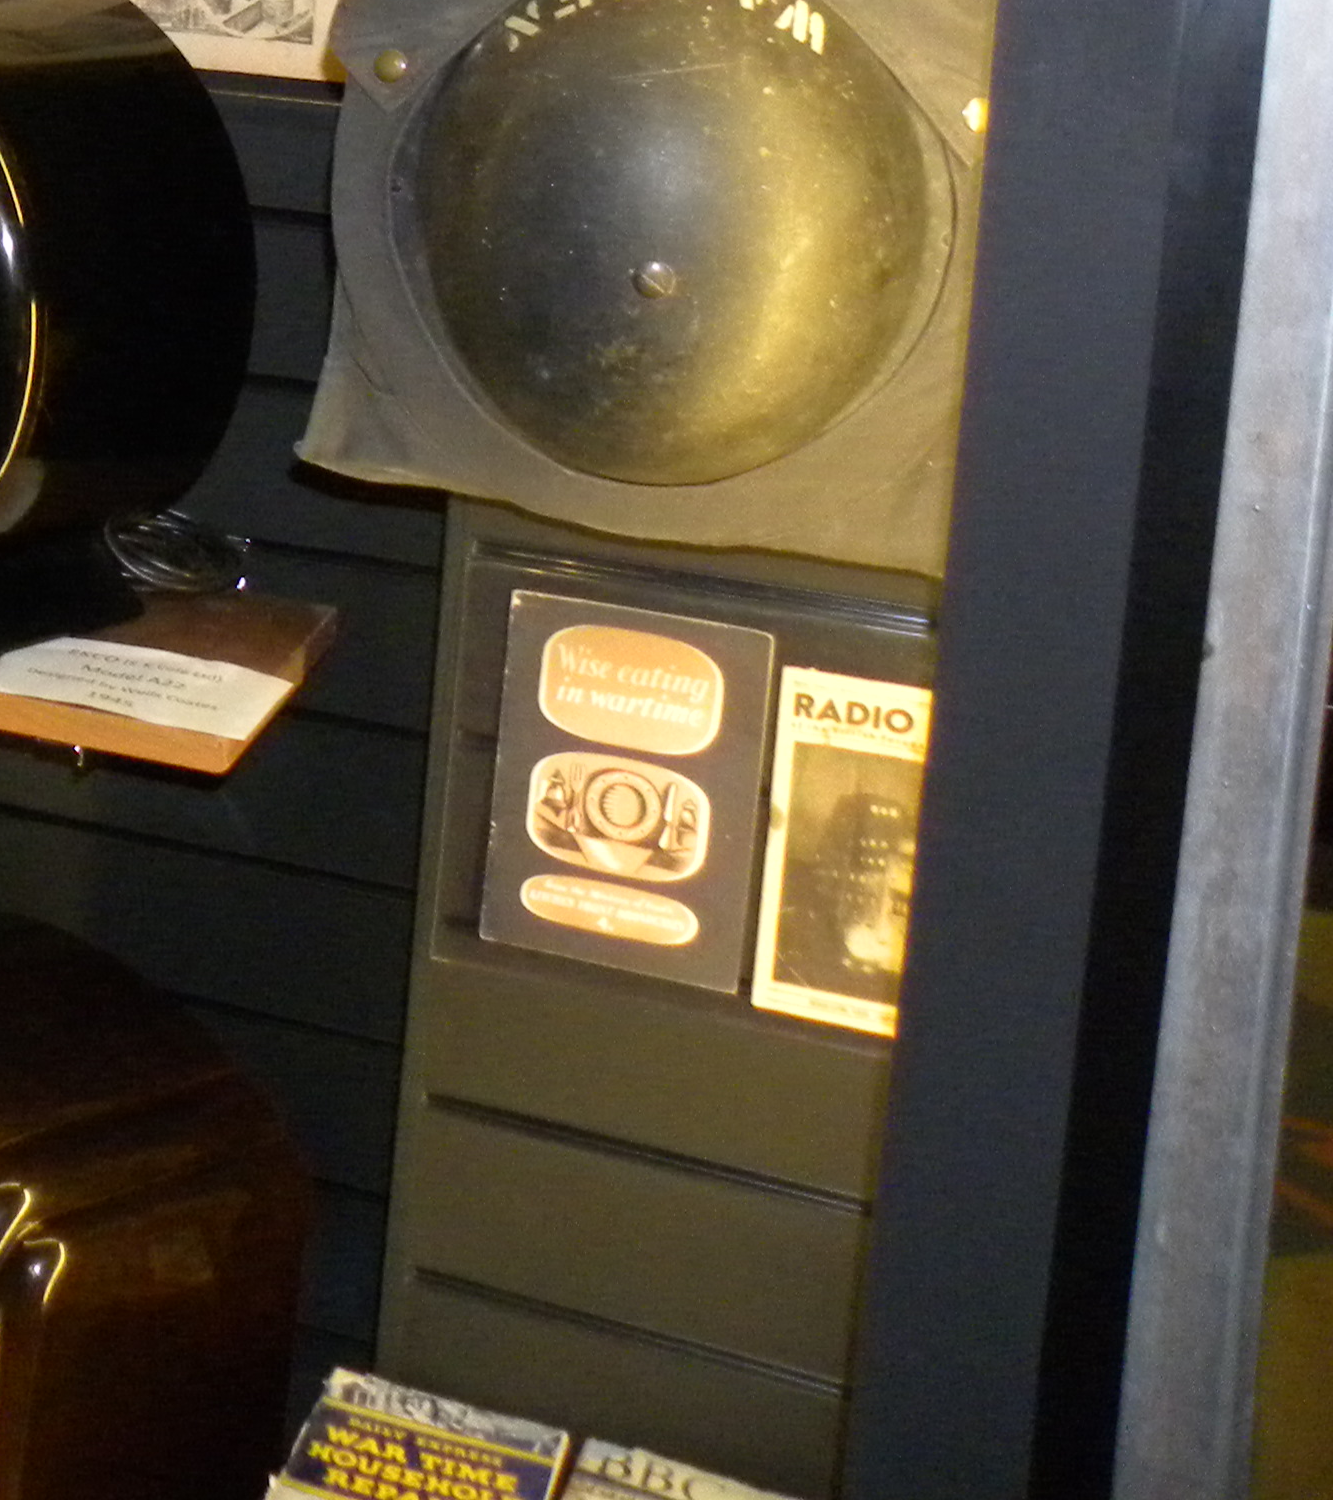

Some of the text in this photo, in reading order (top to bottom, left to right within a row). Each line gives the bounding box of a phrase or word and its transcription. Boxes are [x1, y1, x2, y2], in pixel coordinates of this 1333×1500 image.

[27, 667, 92, 683] Designed
[99, 679, 116, 689] by
[122, 686, 163, 698] Wells
[82, 664, 186, 690] Model A22
[555, 643, 711, 702] Wise eating
[555, 683, 705, 728] in wartime
[793, 691, 915, 735] RADIO
[326, 1425, 518, 1492] WAR TIME
